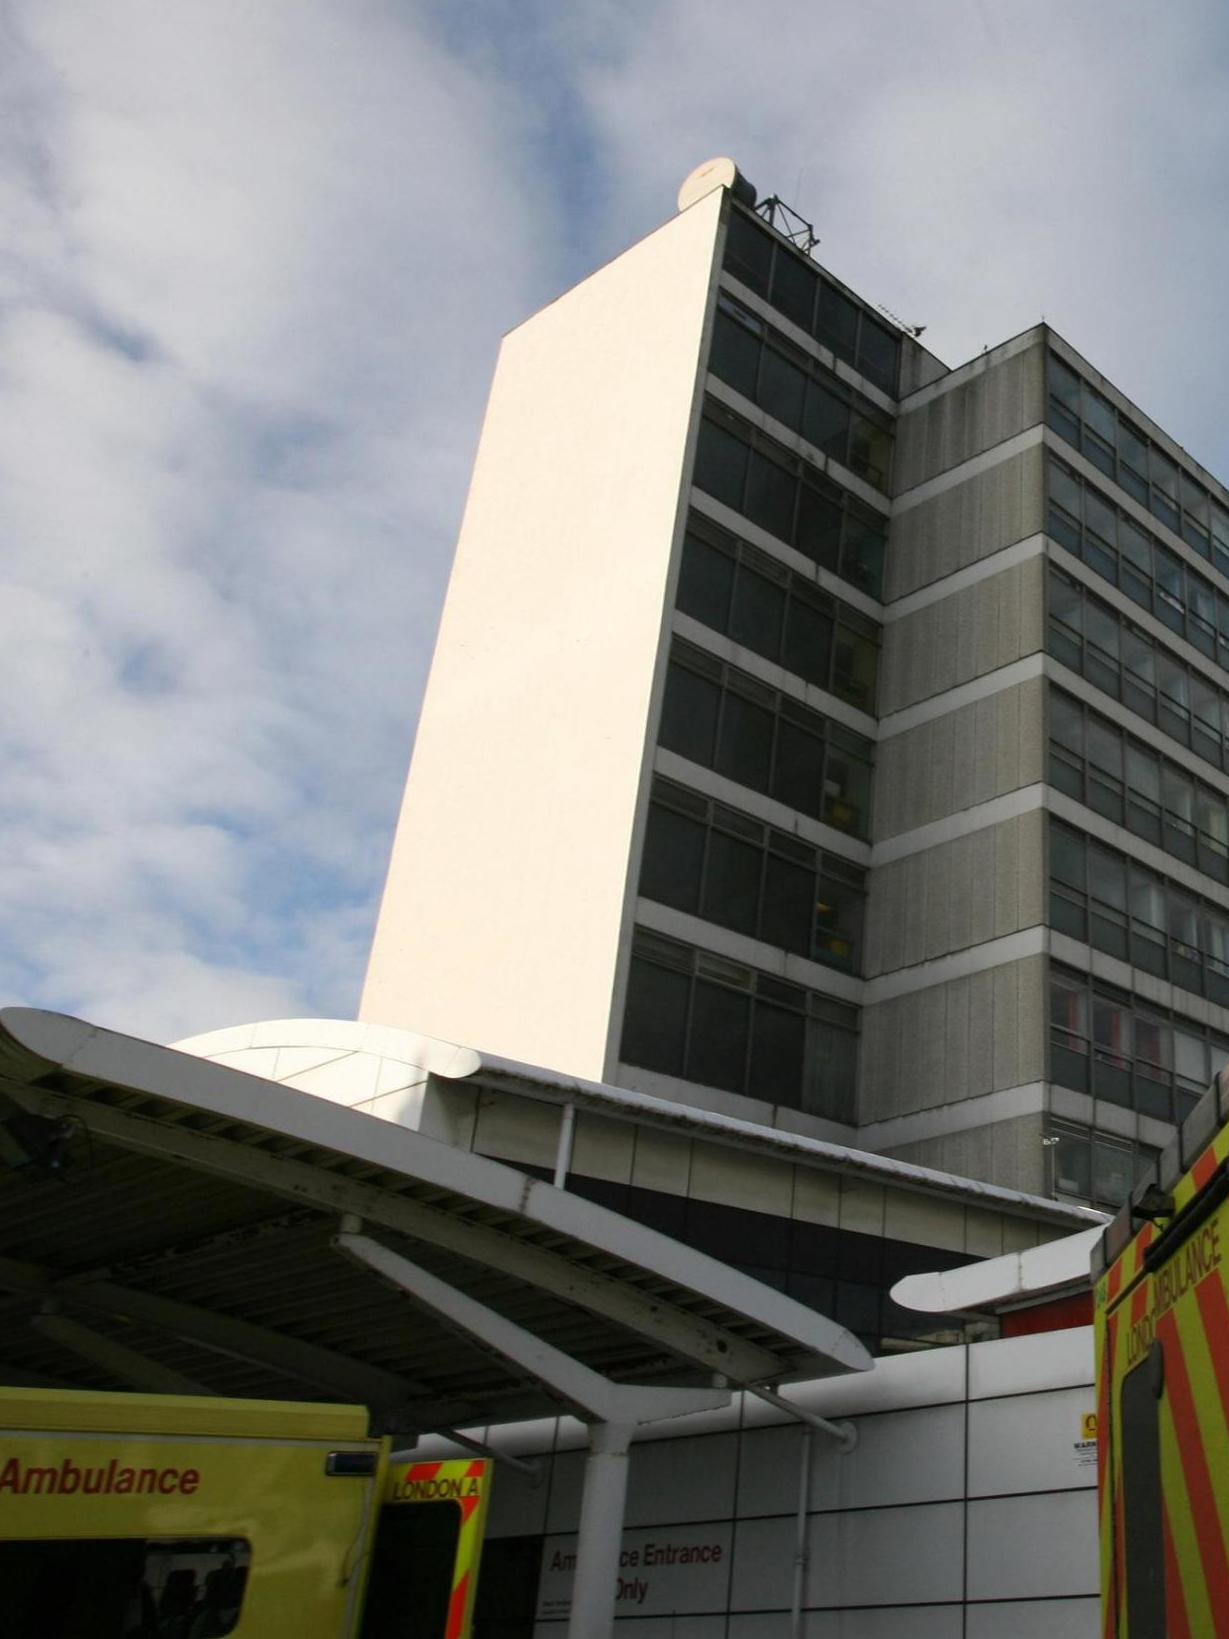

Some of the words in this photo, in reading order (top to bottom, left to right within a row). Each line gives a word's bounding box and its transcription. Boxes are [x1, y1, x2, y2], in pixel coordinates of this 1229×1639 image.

[0, 1457, 201, 1495] Ambulance
[393, 1479, 464, 1500] LONDON
[643, 1544, 722, 1567] Entrance
